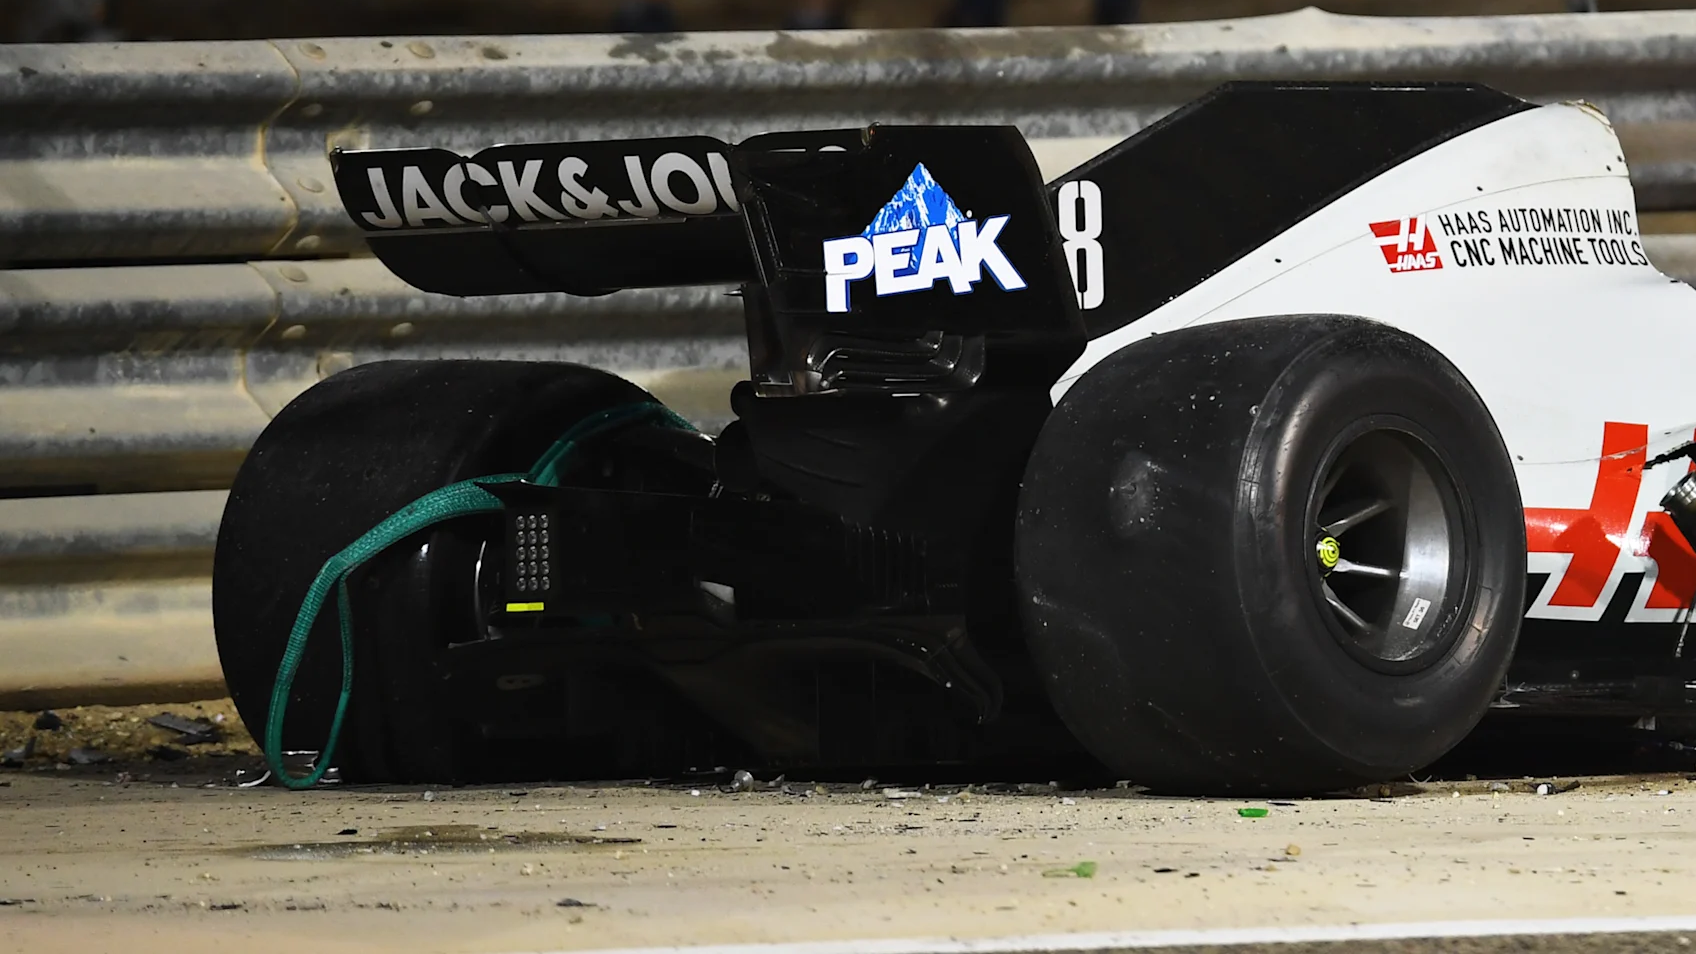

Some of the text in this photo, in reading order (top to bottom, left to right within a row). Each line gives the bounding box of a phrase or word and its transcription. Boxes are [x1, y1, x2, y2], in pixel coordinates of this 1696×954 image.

[361, 152, 740, 229] JACK&JO
[1438, 208, 1638, 236] HAAS AUTOMATION INC.
[822, 214, 1029, 314] PEAK
[1388, 251, 1439, 271] HAAS
[1450, 237, 1649, 268] CNC MACHINE TOOLS
